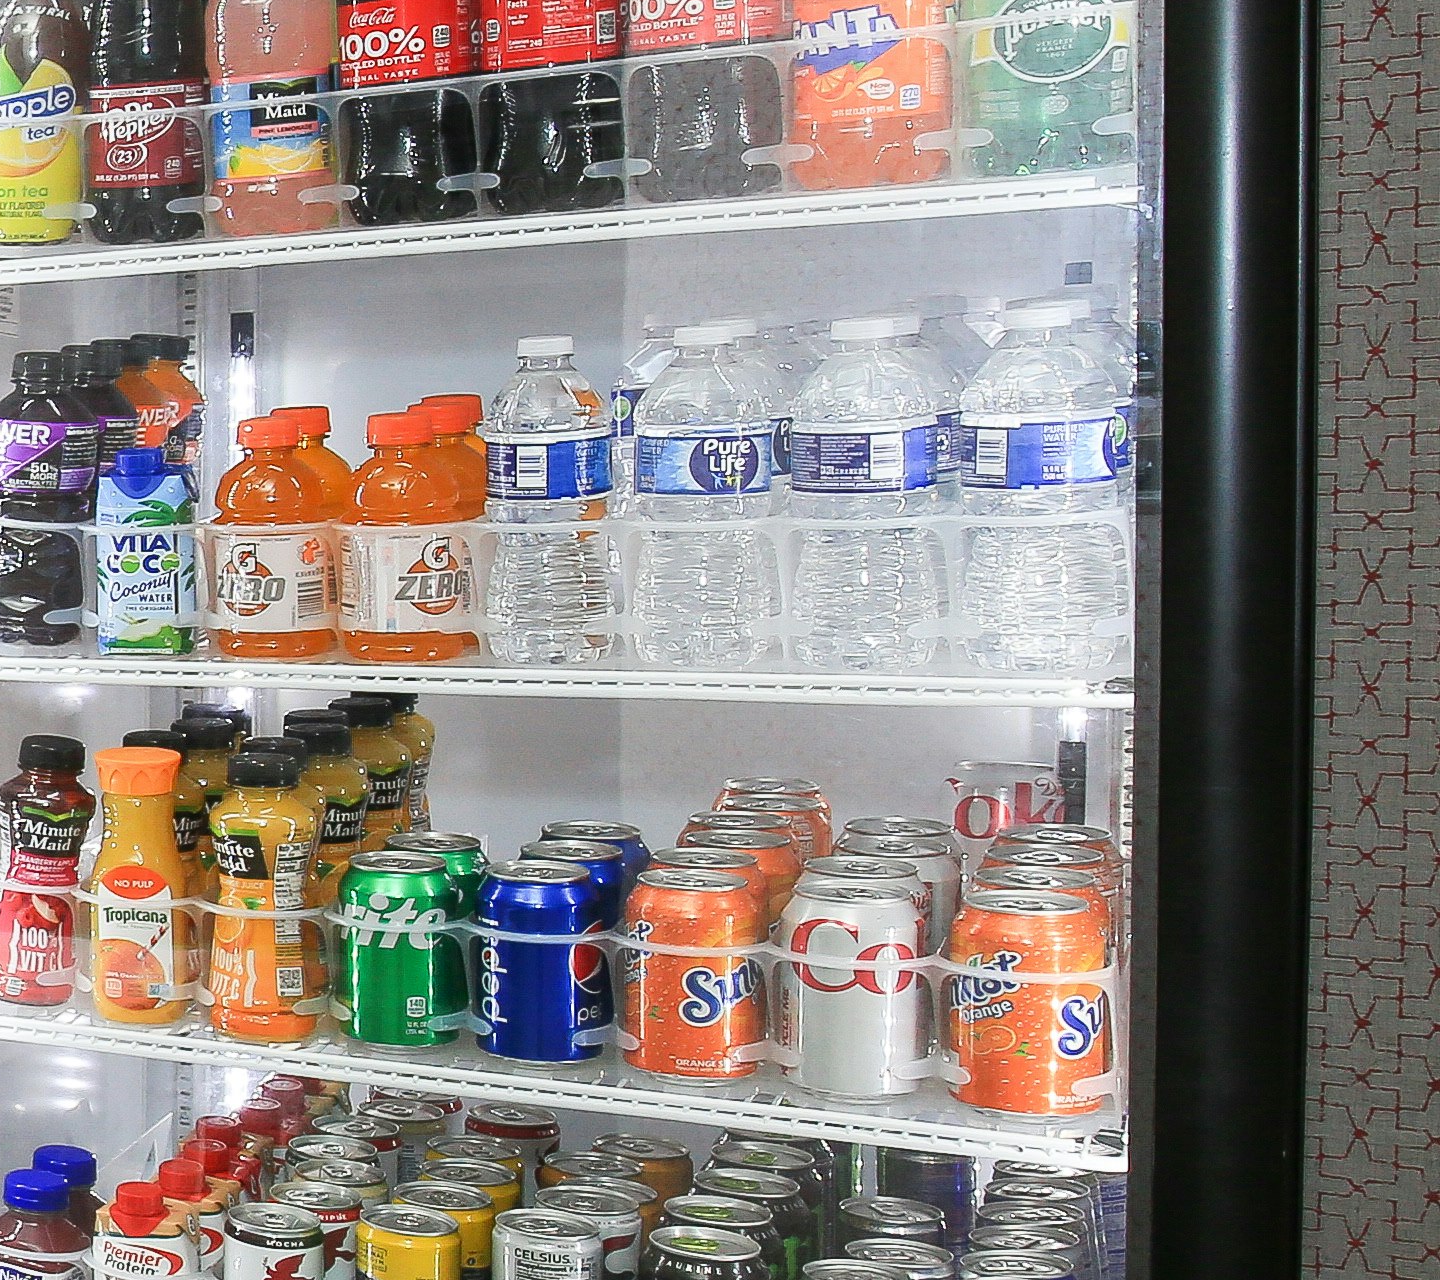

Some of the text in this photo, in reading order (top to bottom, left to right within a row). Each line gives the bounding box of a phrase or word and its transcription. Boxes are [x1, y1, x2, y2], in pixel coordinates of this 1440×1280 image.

[507, 0, 528, 8] Facts
[349, 6, 397, 29] Coca-Cola
[435, 28, 449, 37] 240
[659, 33, 697, 43] TASTE
[793, 6, 900, 59] ANTA
[339, 25, 425, 62] 100%
[384, 69, 418, 78] TASTE
[265, 104, 307, 120] Maid
[27, 125, 55, 141] tea
[276, 124, 313, 134] LEMONADE
[116, 150, 133, 163] 23
[21, 185, 49, 197] tea
[703, 439, 751, 456] Pure
[709, 455, 747, 472] Life
[30, 472, 58, 482] MORE
[113, 533, 172, 552] VITA
[231, 543, 257, 573] G
[421, 537, 452, 570] G
[111, 570, 176, 603] Coconut
[395, 570, 466, 601] ZERO
[138, 592, 173, 603] WATER
[23, 818, 81, 838] Minute
[29, 834, 72, 852] Maid
[114, 878, 154, 890] NO PULP
[103, 906, 168, 925] Tropicana
[341, 893, 447, 950] rite
[21, 951, 47, 972] VIT
[409, 998, 424, 1008] 140
[266, 1239, 304, 1248] MOCHA
[104, 1241, 163, 1266] Premier
[514, 1247, 570, 1265] CELSIUS
[105, 1254, 158, 1275] Protein
[658, 1256, 722, 1277] TAURINE
